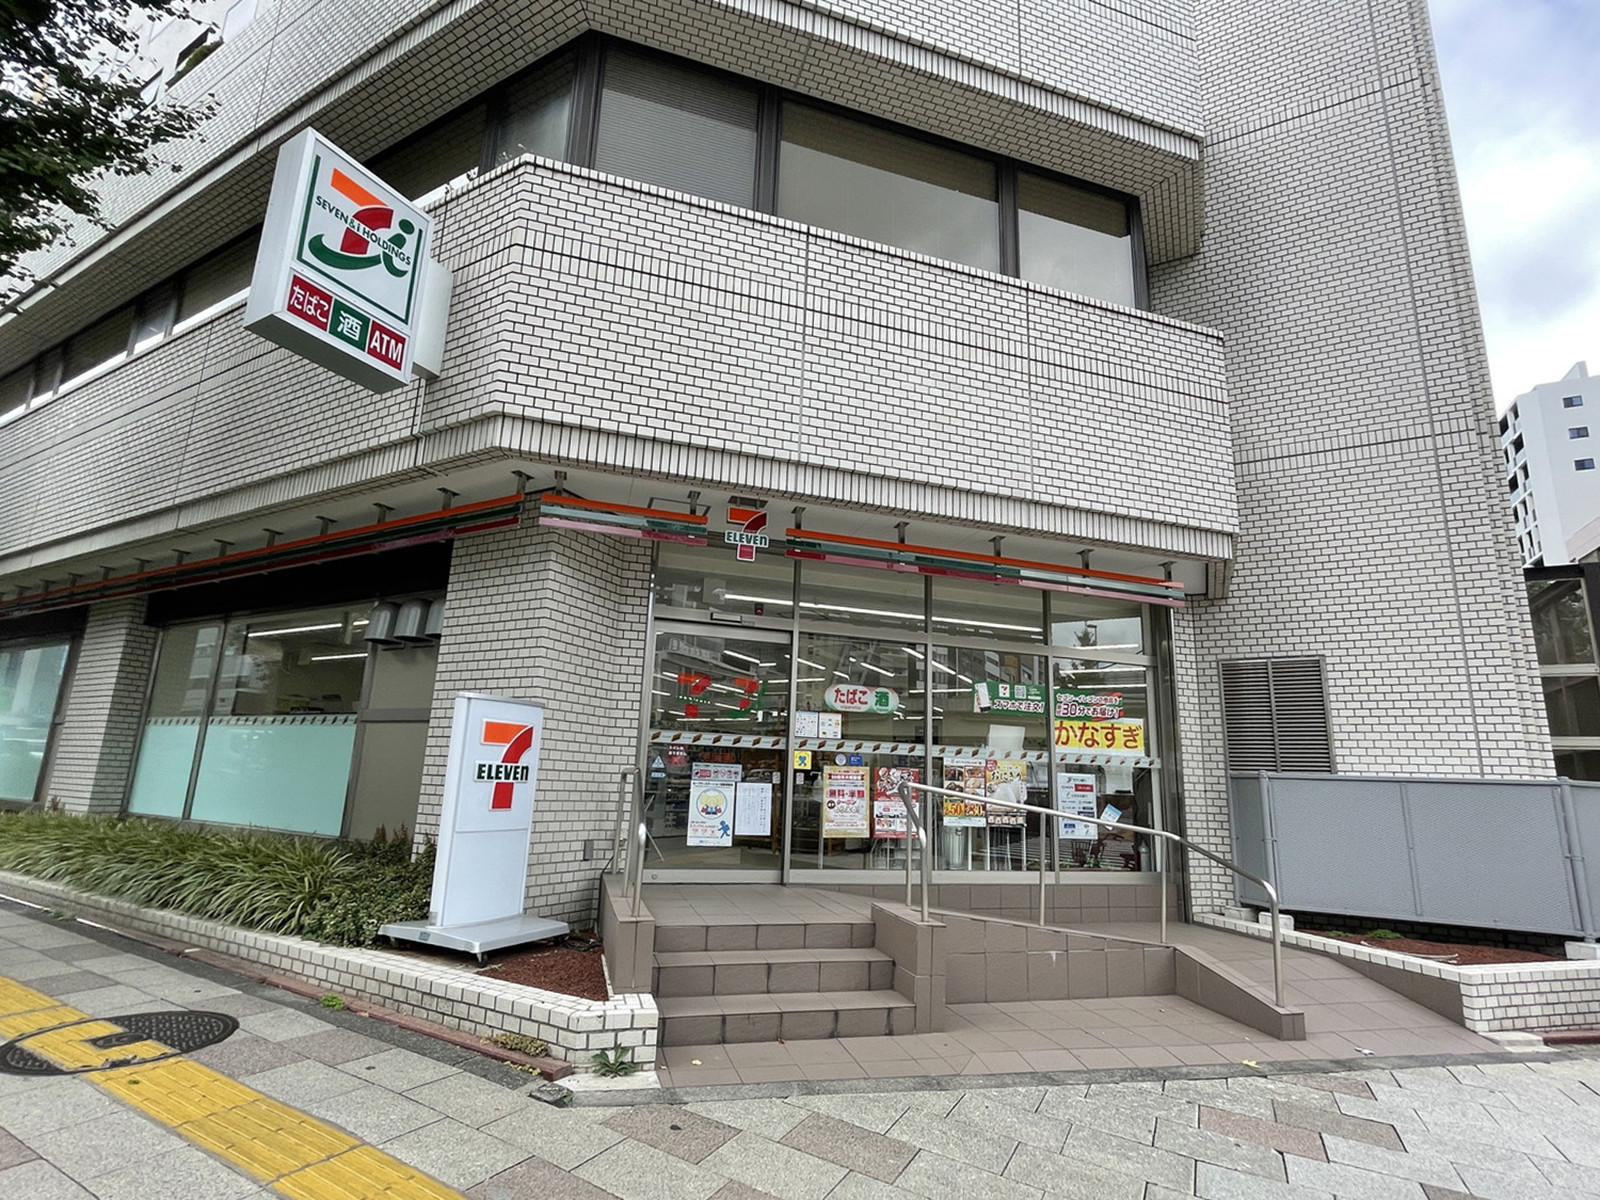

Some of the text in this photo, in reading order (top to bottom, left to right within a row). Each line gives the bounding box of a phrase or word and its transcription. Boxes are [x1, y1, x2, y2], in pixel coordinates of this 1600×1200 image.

[361, 228, 412, 266] HOLDINGS
[290, 284, 330, 323] たばこ
[337, 310, 362, 341] 酒
[370, 332, 404, 364] ATM
[834, 688, 890, 707] たばこ 酒
[1055, 720, 1142, 749] かなすぎ
